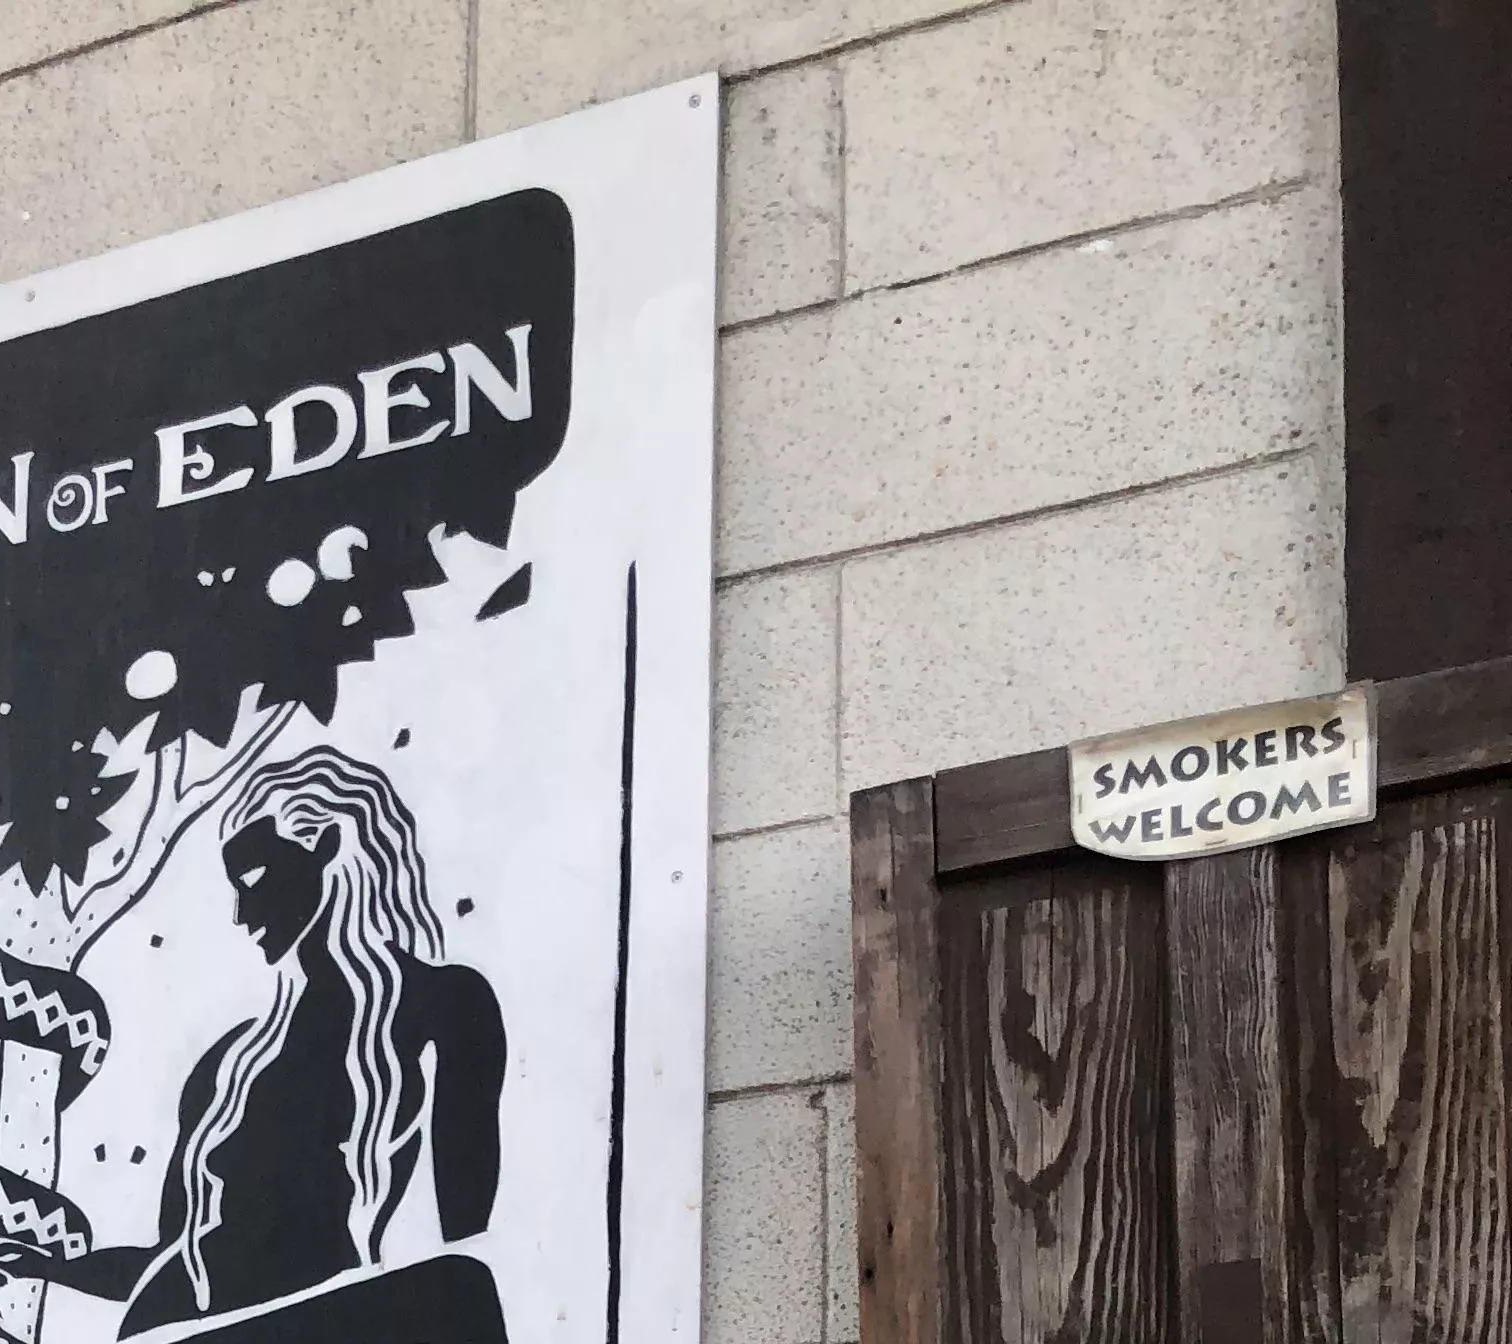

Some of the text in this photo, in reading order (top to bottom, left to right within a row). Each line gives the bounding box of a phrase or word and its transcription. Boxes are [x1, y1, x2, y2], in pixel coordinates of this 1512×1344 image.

[46, 458, 134, 533] OF
[154, 323, 533, 510] EDEN
[1093, 716, 1346, 799] SMOKERS
[1088, 772, 1352, 844] WELCOME
